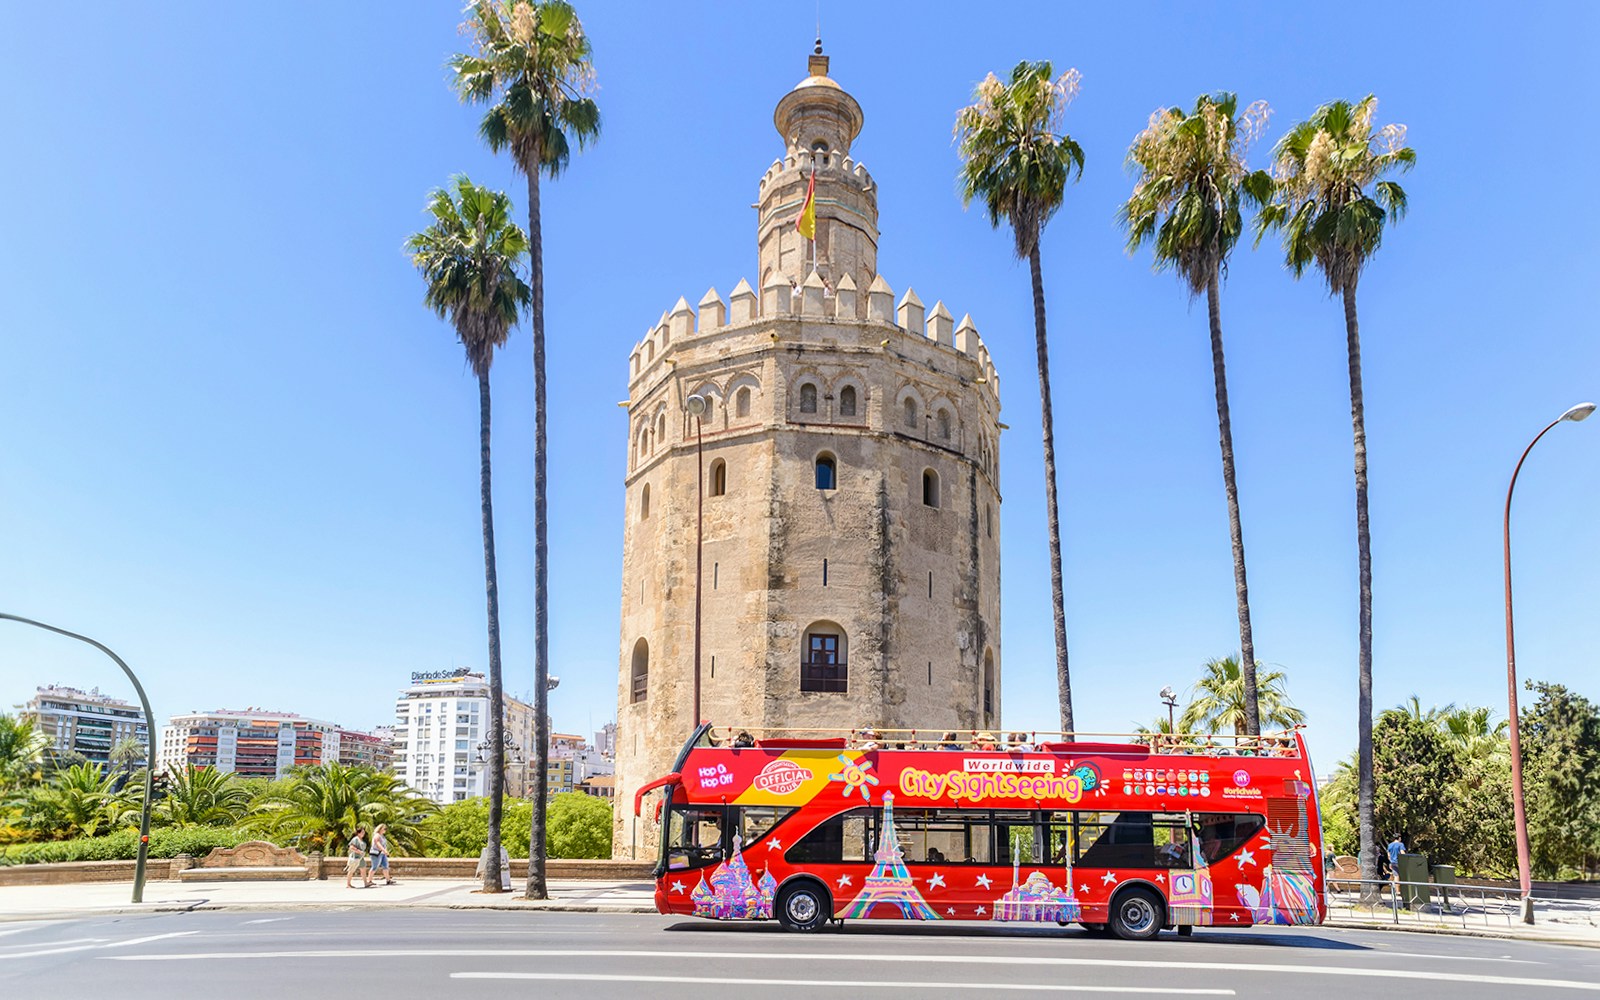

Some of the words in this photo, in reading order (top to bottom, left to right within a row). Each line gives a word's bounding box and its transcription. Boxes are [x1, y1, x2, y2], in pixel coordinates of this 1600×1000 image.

[411, 671, 432, 680] Diario
[433, 670, 441, 679] de
[967, 759, 1050, 771] Worldwide
[698, 767, 717, 777] Hop
[700, 777, 719, 788] Hop
[719, 773, 734, 785] Off
[759, 770, 810, 787] OFFICIAL
[775, 782, 798, 793] TOUR
